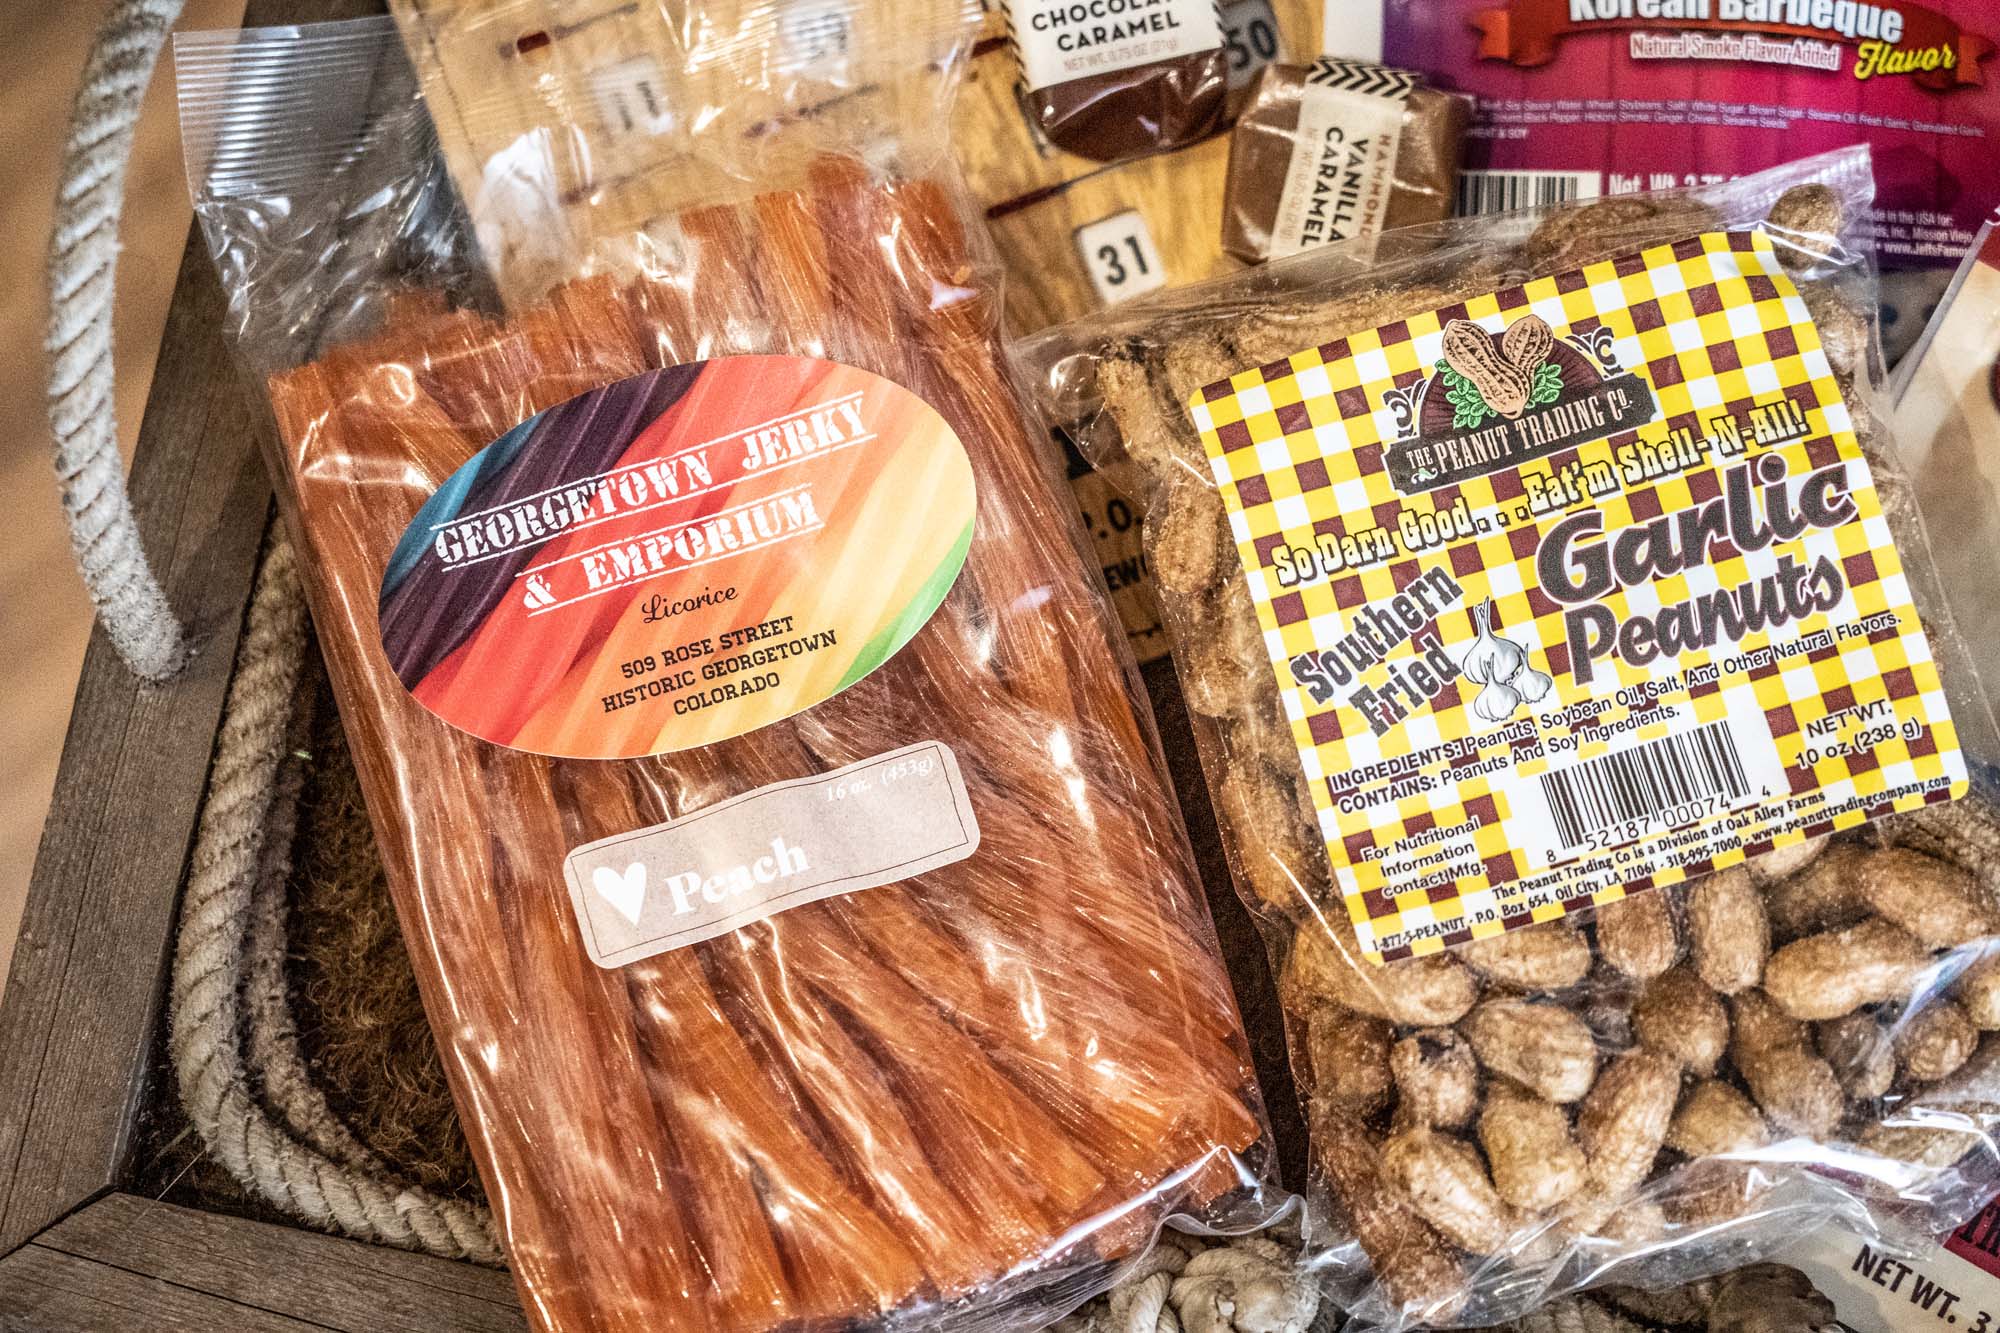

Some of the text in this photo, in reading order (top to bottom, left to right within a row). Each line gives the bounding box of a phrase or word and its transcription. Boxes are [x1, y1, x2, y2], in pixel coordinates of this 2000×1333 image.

[1057, 11, 1180, 51] CARAMEL
[1226, 20, 1277, 70] 50
[1630, 31, 1841, 70] Natural Smoke Flavor Added
[1854, 40, 1956, 79] Flavor
[1301, 127, 1344, 246] CARAMEL
[1328, 139, 1368, 243] VANILLA
[1608, 172, 1640, 196] Net
[1915, 211, 1935, 225] USA
[1097, 235, 1151, 287] 31
[1406, 447, 1433, 469] THE
[1435, 425, 1512, 474] PEANUT
[1514, 395, 1605, 450] TRADING
[435, 398, 867, 566] GEORGETOWN JERKY
[523, 492, 823, 610] & EMPORIUM
[1271, 544, 1317, 588] So
[1314, 526, 1399, 576] Darn
[1520, 457, 1621, 517] Eat'm
[1537, 453, 1857, 603] Garlic
[641, 584, 739, 625] Licorice
[1290, 566, 1463, 704] Southern
[1563, 553, 1846, 686] Peanuts
[602, 630, 837, 713] HISTORIC GEORGETOWN
[621, 617, 794, 679] 509 ROSE STREET
[1348, 634, 1463, 738] Fried
[673, 672, 781, 716] COLORADO
[1331, 611, 1902, 791] INGREDIENTS: Peanuts, Soybean Oil, Salt, And Other Natural Flavors.
[1806, 698, 1893, 738] NET WT.
[827, 783, 846, 801] 16
[880, 755, 934, 785] (453g)
[1338, 707, 1680, 814] CONTAINS: Peanuts And Soy Ingredients.
[1796, 716, 1922, 769] 10 oz (238 g)
[1362, 817, 1480, 862] For Nutritional
[1372, 774, 1952, 951] 1-877-5-PEANUT P.O. Box 654, Oil City, LA 71061 318-995-7000 www.peanuttradingcompany.com
[1380, 842, 1475, 877] Information
[1492, 791, 1827, 901] The Peanut Trading Co is a Division of Oak Alley Farms
[1546, 784, 1772, 864] 8 52187 00074 4
[665, 836, 811, 917] Peach
[1383, 872, 1446, 897] contact
[1851, 1244, 1914, 1293] NET
[1908, 1274, 1961, 1324] WT.
